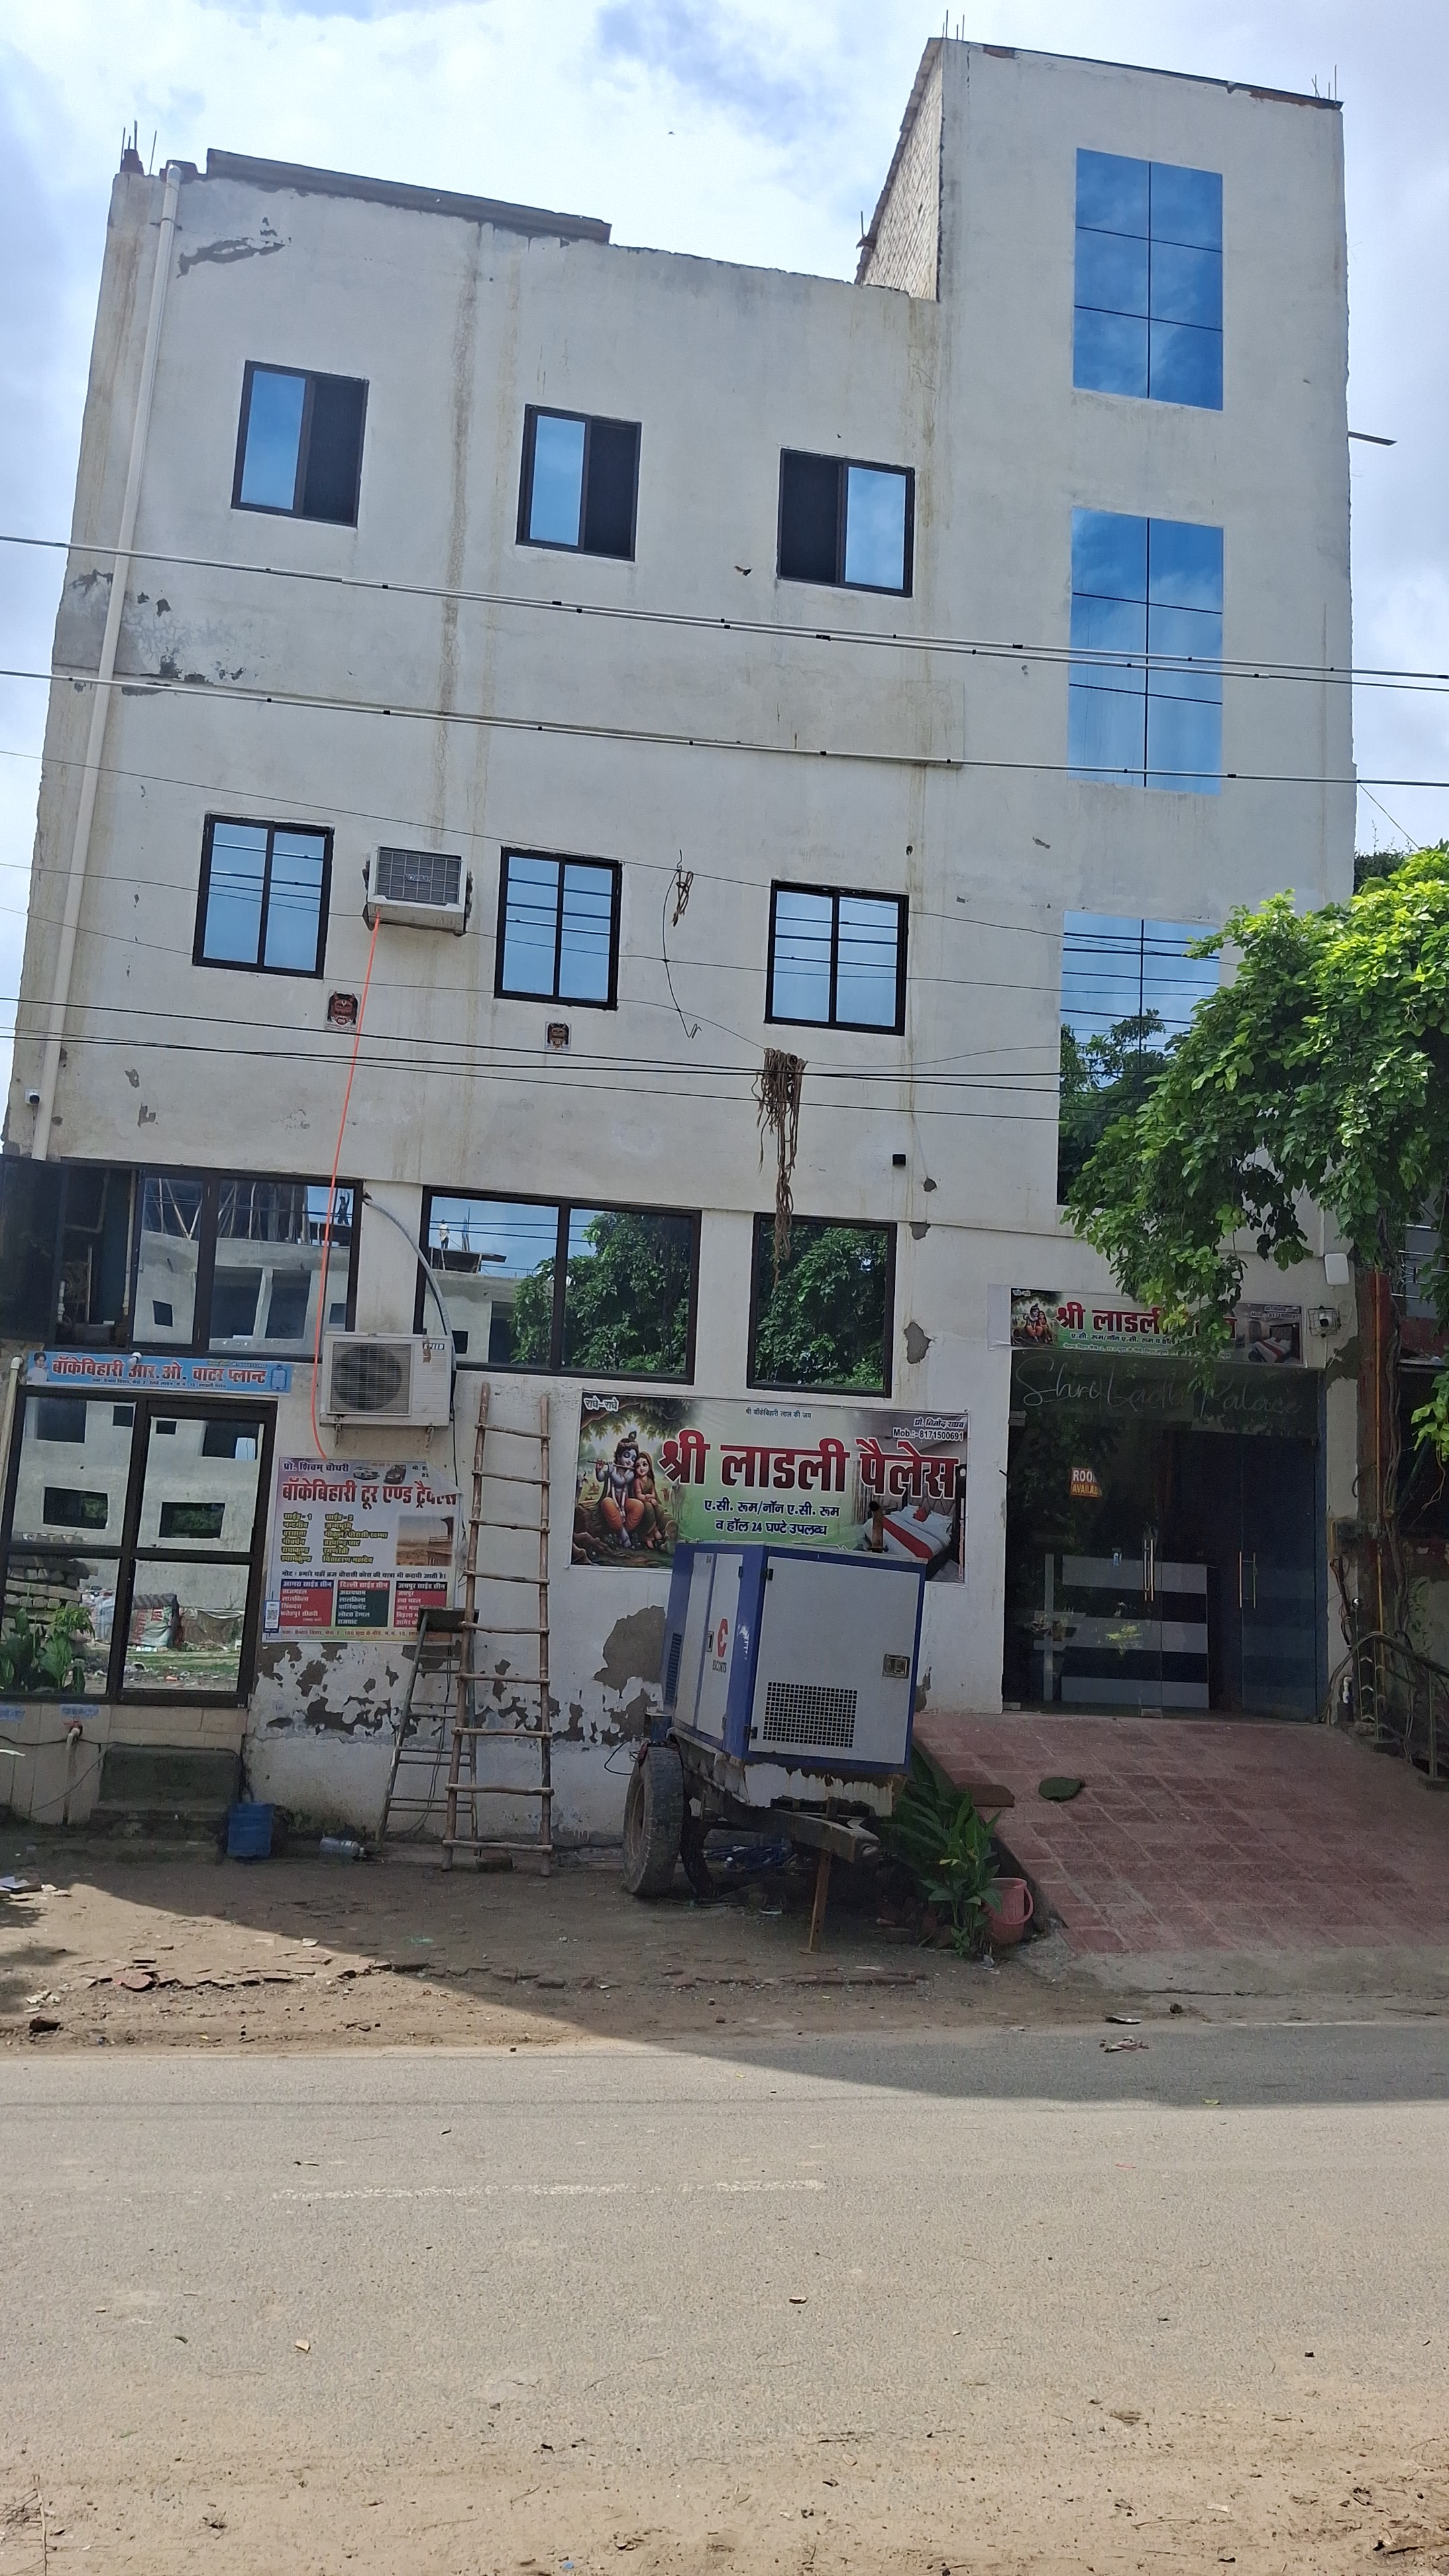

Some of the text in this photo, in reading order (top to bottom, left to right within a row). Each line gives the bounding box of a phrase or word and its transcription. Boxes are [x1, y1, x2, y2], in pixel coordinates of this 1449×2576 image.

[1056, 1301, 1086, 1330] श्री
[193, 1366, 225, 1382] वाटर
[228, 1369, 267, 1385] प्लान्ट
[1016, 1356, 1102, 1406] Shri
[793, 1409, 800, 1417] की
[919, 1429, 963, 1442] 8171500691
[283, 1462, 297, 1472] प्रो.
[657, 1428, 960, 1500] श्री लाडली पैलेस
[1073, 1470, 1095, 1483] ROO
[361, 1485, 379, 1510] टूर
[382, 1486, 413, 1503] एण्ड
[704, 1497, 733, 1511] ए.सी.
[787, 1501, 816, 1516] ए.सी.
[819, 1506, 840, 1517] रूम
[715, 1519, 724, 1531] व
[727, 1517, 749, 1532] हॉल
[751, 1522, 762, 1532] 24
[765, 1520, 788, 1534] घण्टे
